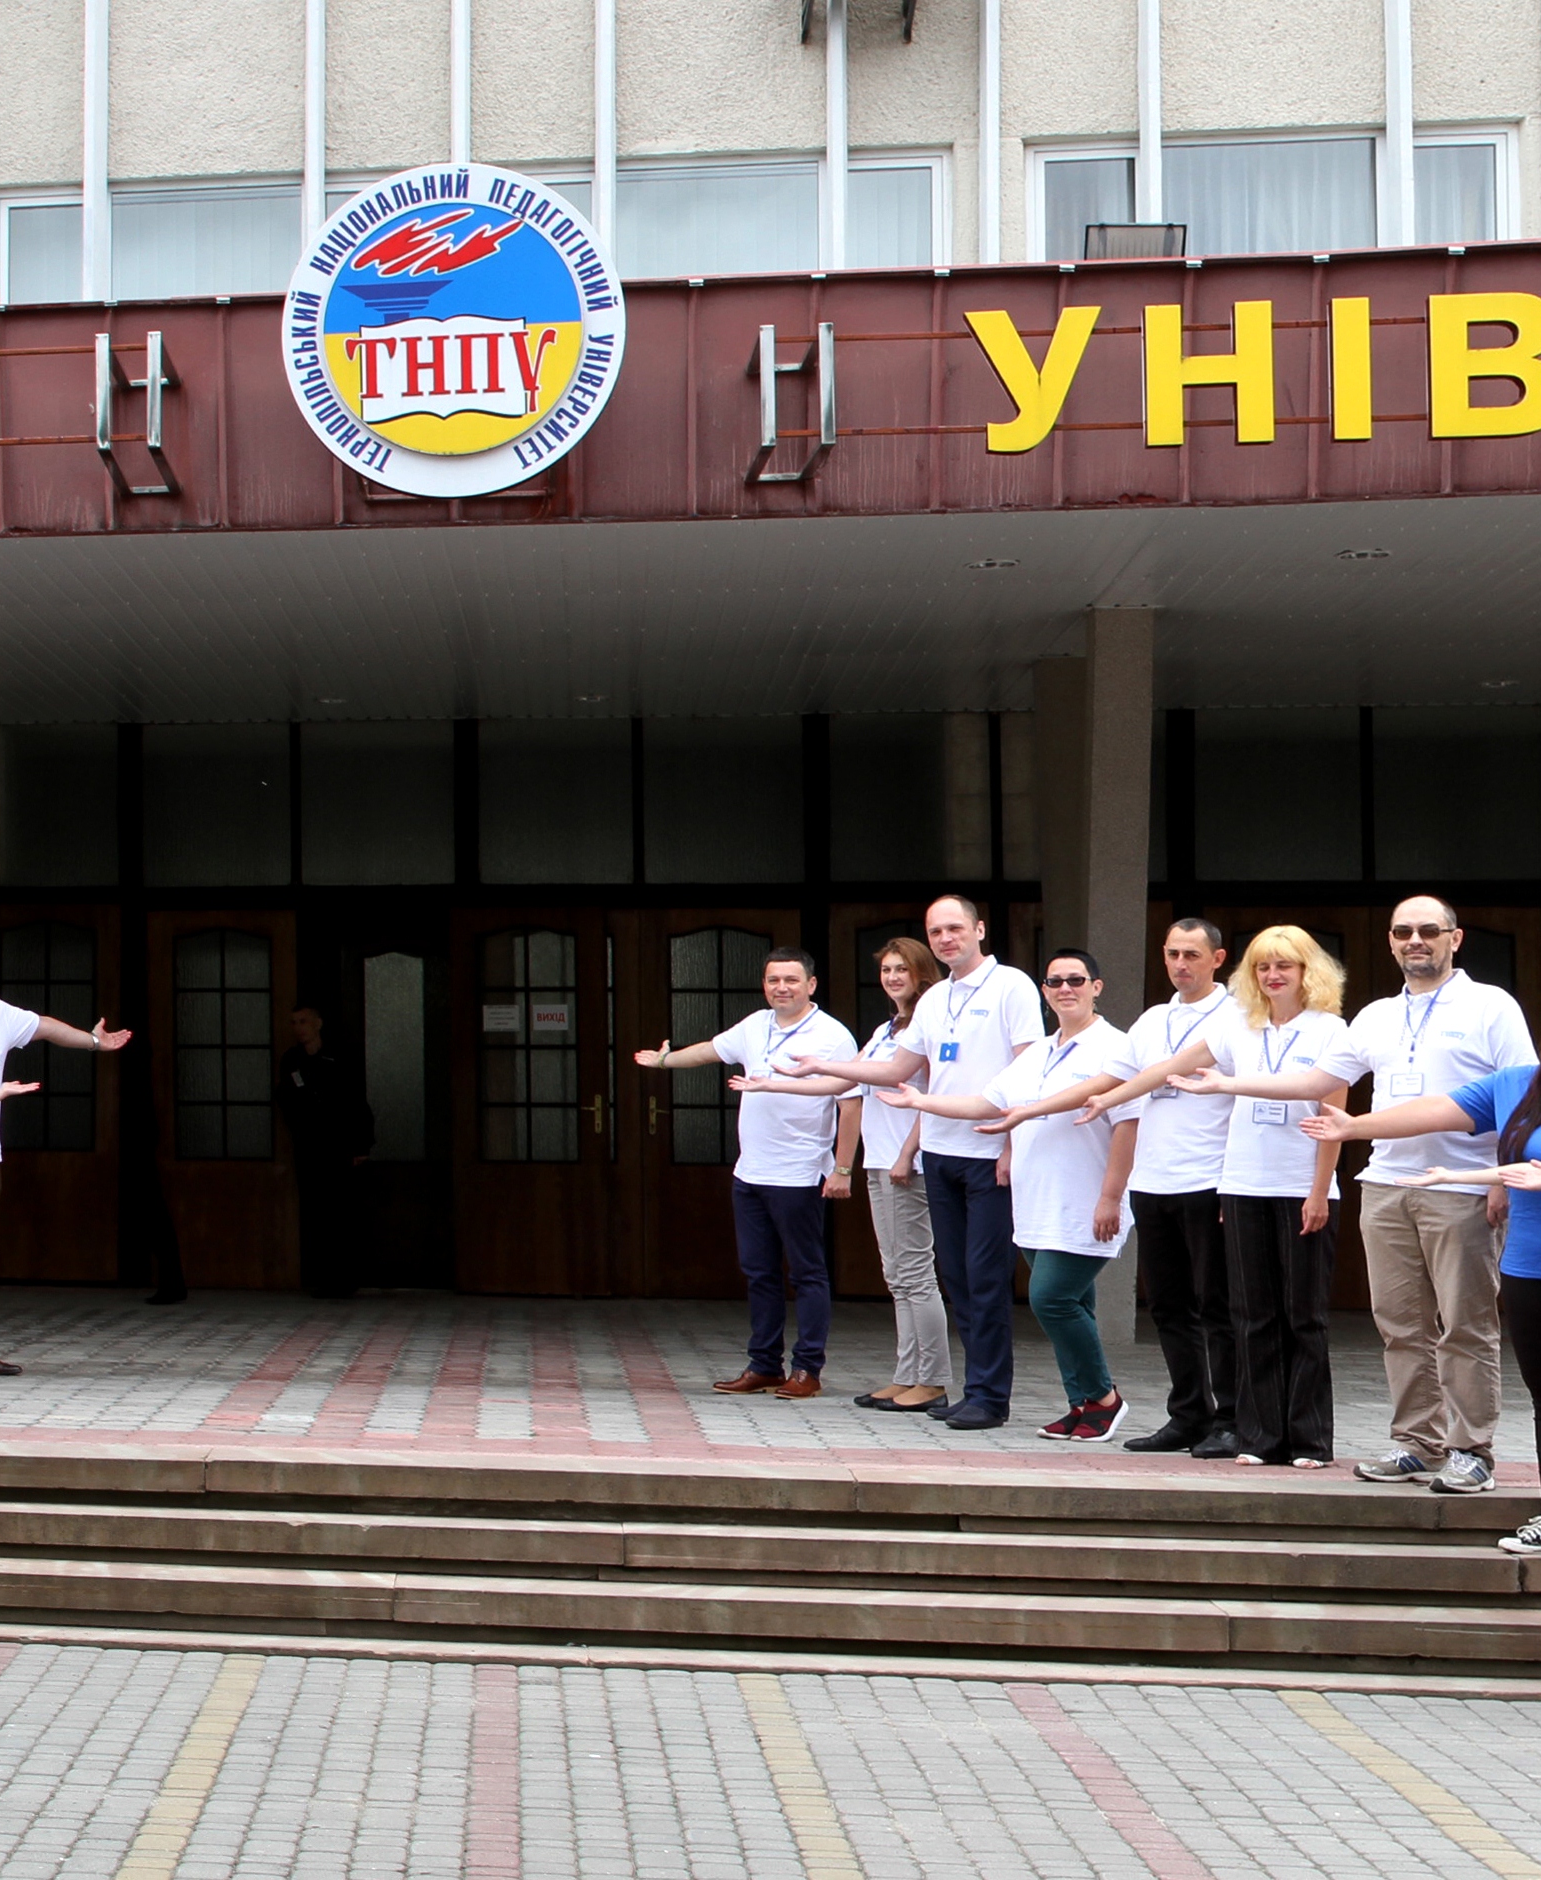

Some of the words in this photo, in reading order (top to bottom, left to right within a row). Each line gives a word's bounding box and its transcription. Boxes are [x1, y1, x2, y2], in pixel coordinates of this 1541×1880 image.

[309, 168, 470, 277] НАЦІОНАЛЬНИЙ
[488, 177, 620, 313] ПЕДАГОГІЧНИЙ
[291, 290, 394, 474] ТЕРНОПІЛЬСЬКИЙ
[345, 328, 557, 414] ТНПУ
[512, 333, 615, 470] УНІВЕРСИТЕТ
[536, 1012, 566, 1023] ВИХІД
